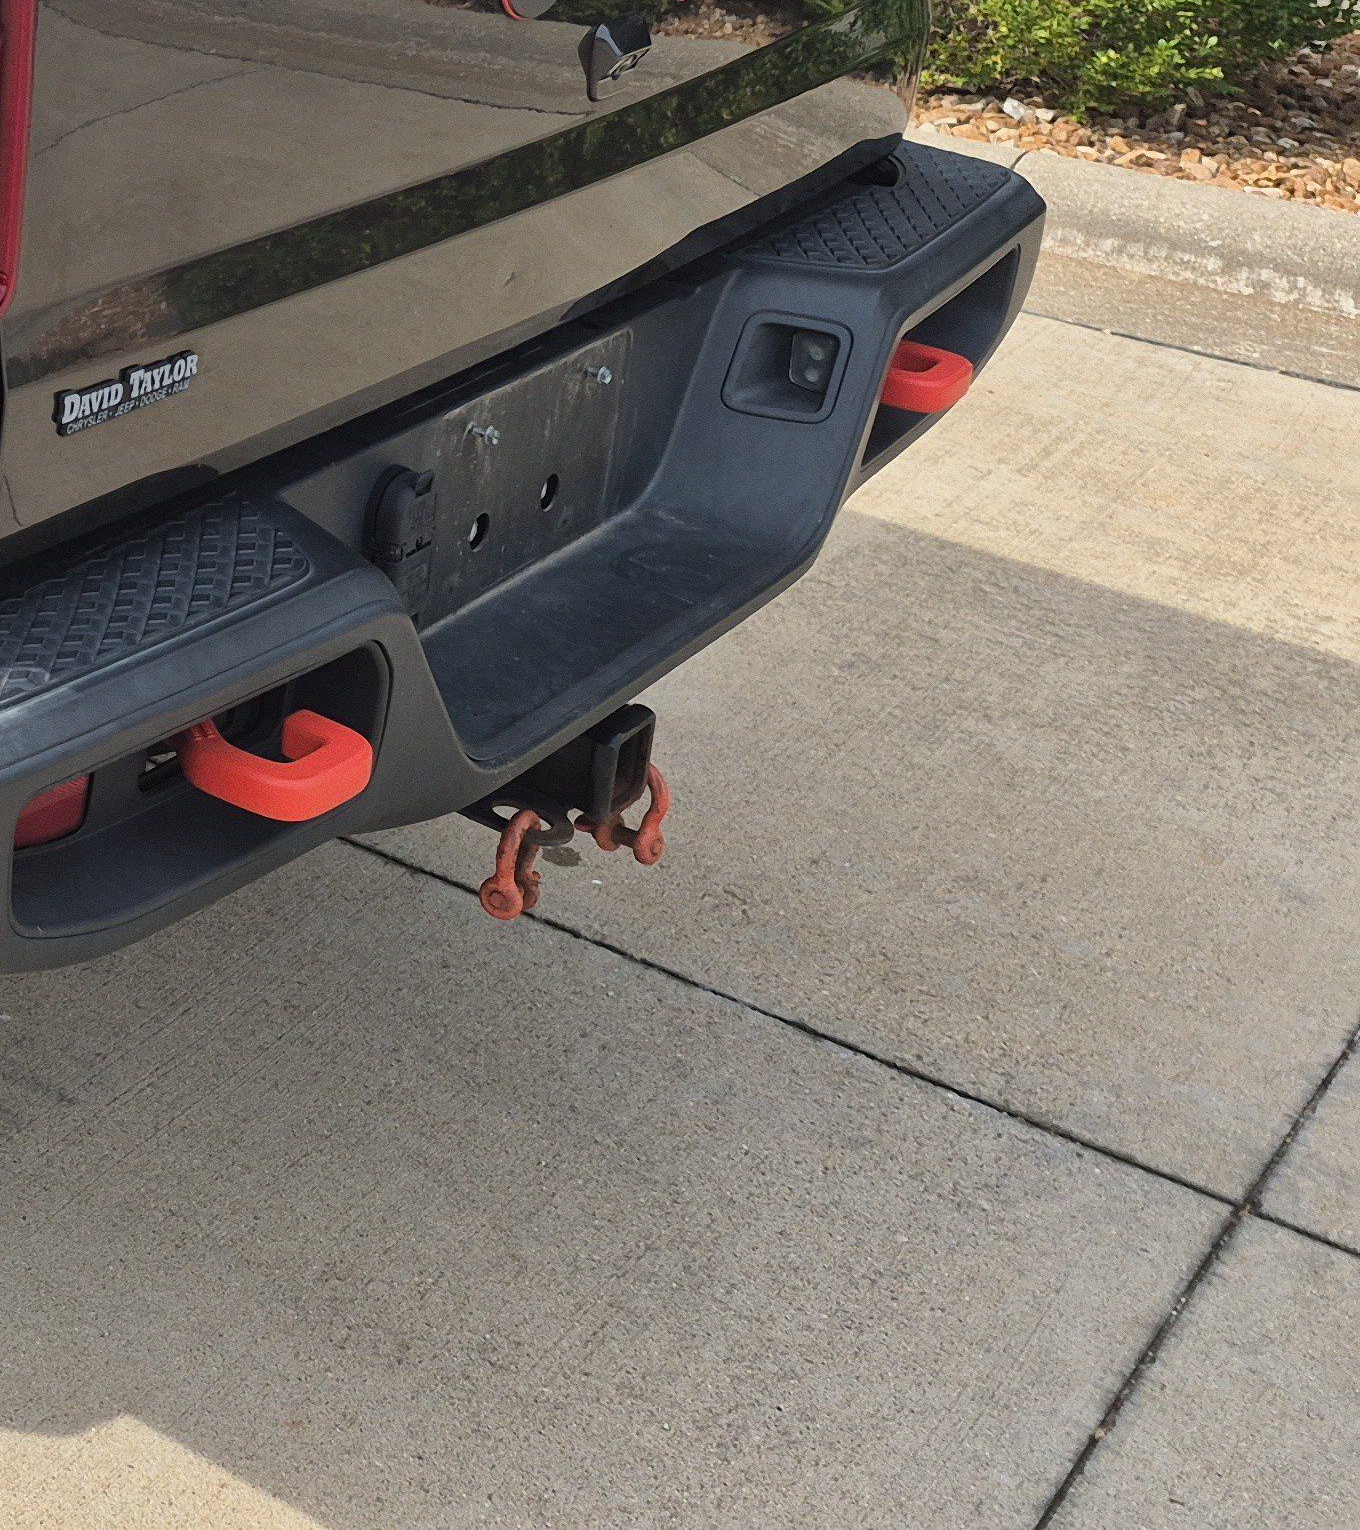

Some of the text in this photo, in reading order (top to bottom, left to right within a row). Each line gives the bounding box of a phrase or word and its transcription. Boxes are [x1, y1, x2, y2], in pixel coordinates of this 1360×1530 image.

[61, 354, 199, 425] DAVID TAYLOR
[66, 412, 108, 435] CHRYSLER
[115, 400, 136, 417] JEEP
[140, 388, 168, 408] DODGE
